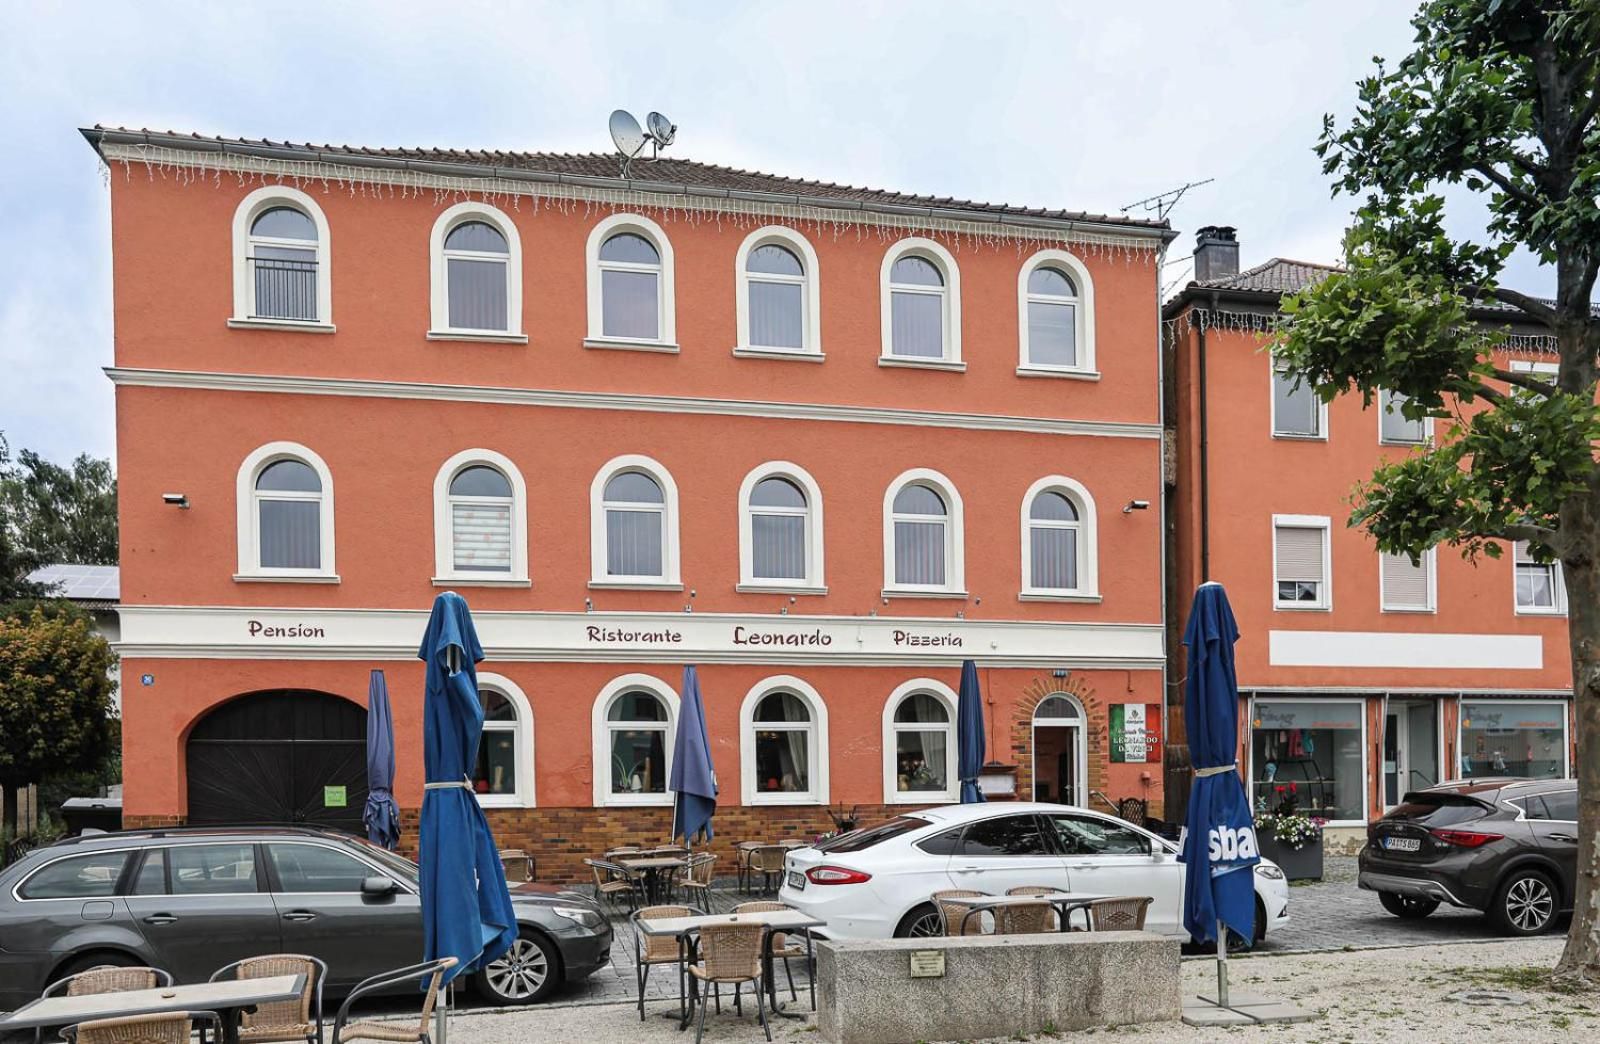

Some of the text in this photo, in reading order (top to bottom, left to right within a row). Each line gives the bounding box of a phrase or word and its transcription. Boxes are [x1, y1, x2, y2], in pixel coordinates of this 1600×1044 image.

[247, 620, 962, 647] Pension Ristorante Leonardo Pizzeria
